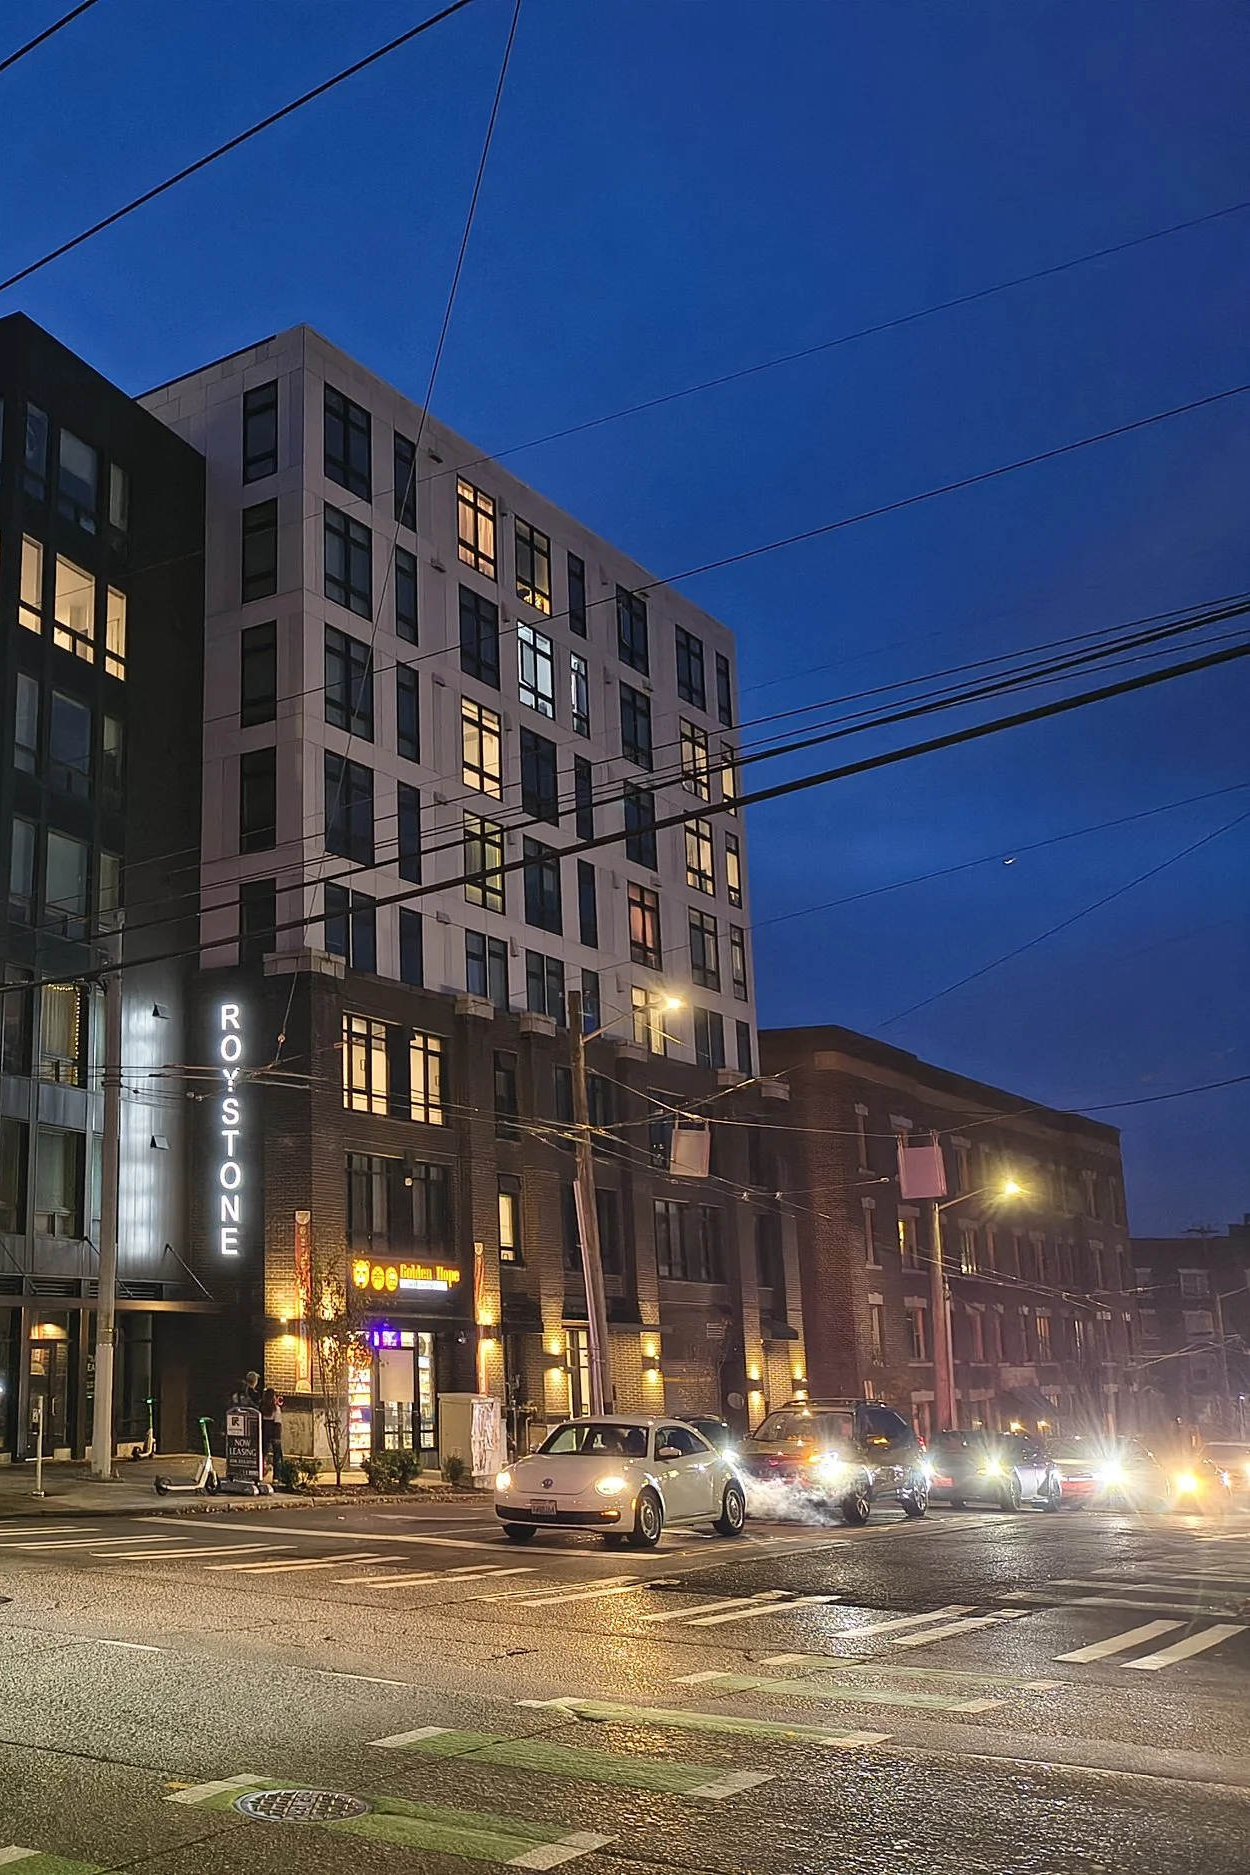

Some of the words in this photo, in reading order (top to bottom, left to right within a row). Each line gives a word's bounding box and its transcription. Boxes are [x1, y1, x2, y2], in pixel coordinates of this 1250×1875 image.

[219, 1003, 243, 1256] ROYSTONE
[399, 1263, 433, 1280] Golden
[435, 1265, 461, 1288] Hope
[235, 1439, 251, 1447] NOW
[229, 1447, 257, 1457] LEASING
